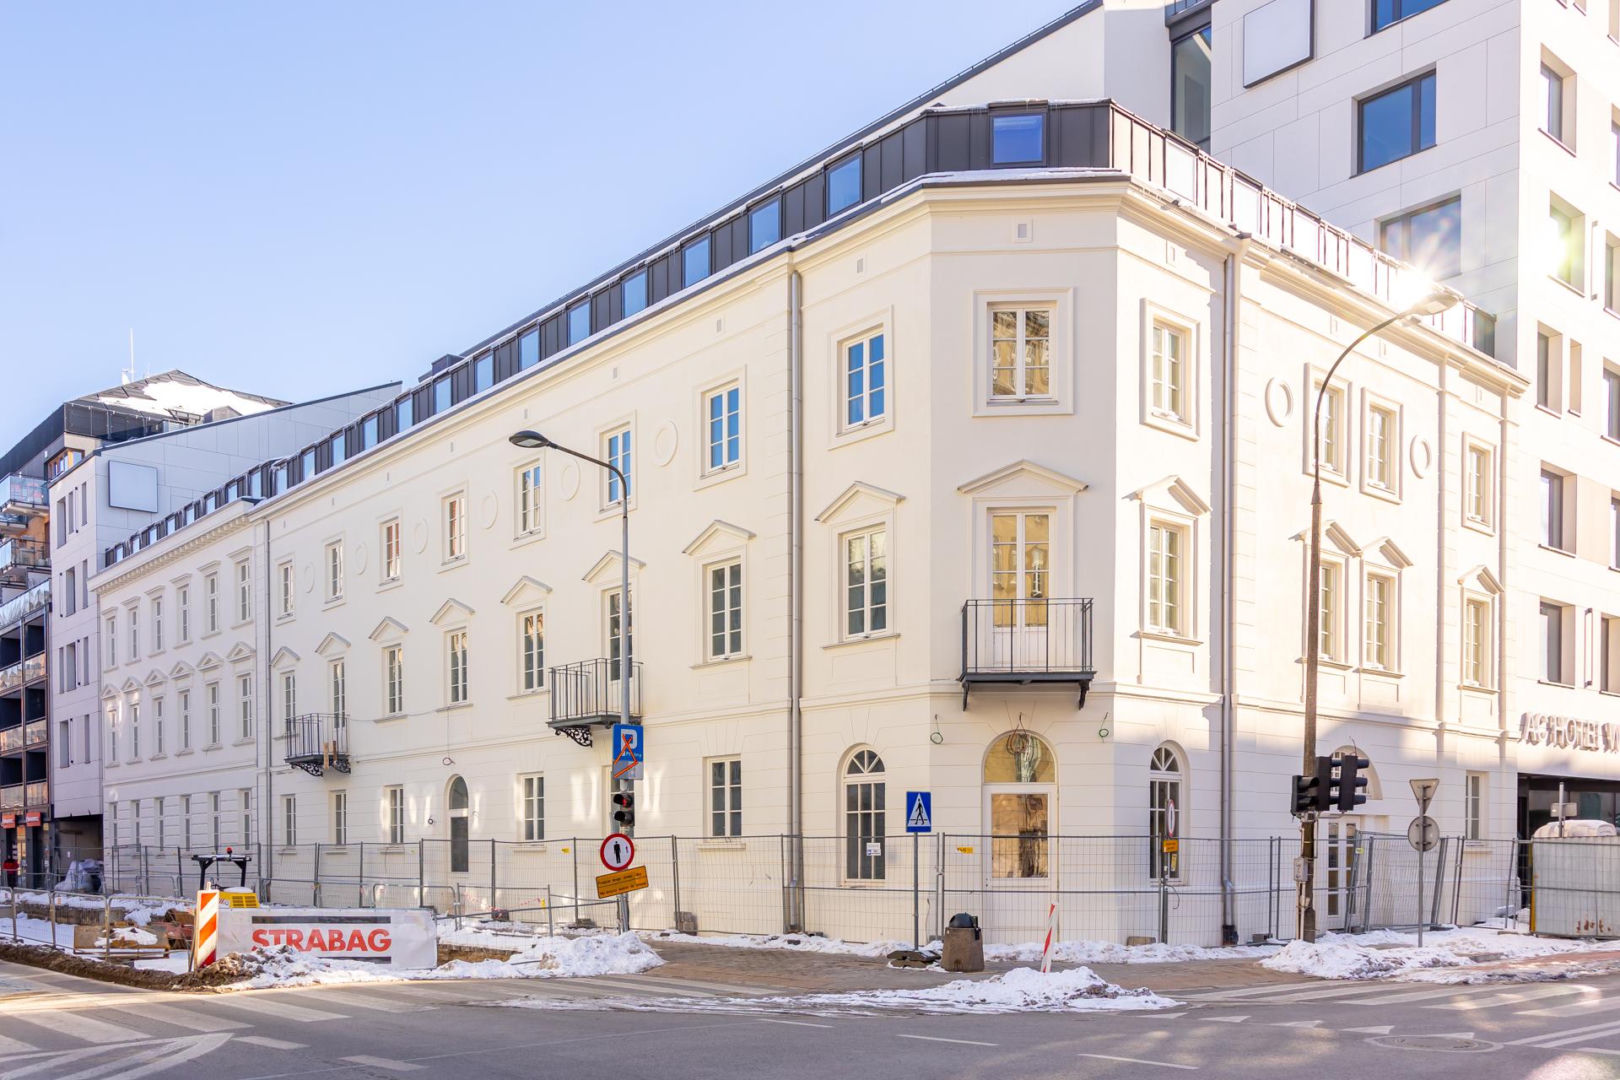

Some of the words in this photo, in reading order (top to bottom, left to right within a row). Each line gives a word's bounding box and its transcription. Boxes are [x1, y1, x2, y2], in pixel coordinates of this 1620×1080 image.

[620, 729, 638, 757] P
[1520, 712, 1548, 745] AC
[1547, 716, 1599, 751] HOTEL
[252, 928, 392, 952] STRABAG
